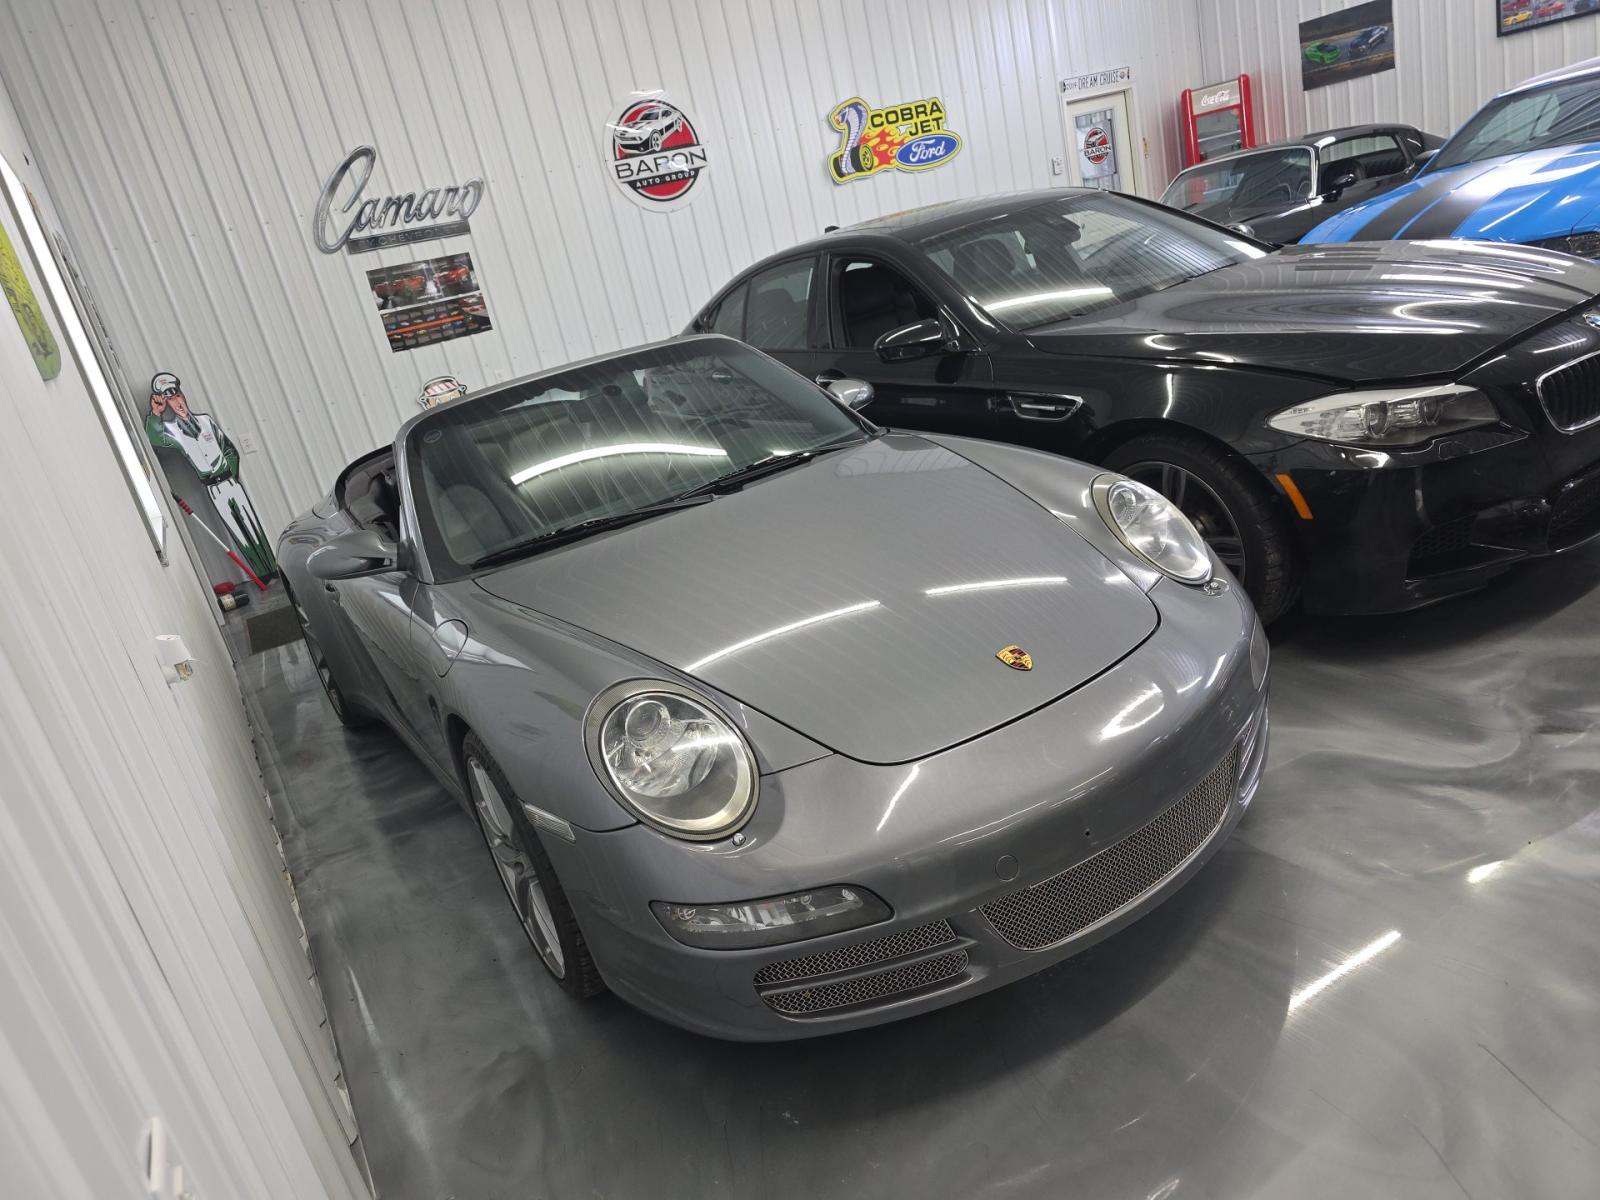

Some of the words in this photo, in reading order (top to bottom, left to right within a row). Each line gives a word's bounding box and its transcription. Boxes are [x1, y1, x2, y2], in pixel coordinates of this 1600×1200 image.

[1078, 74, 1098, 90] DREAM
[1100, 70, 1119, 86] CRUISE
[870, 101, 943, 128] COBRA
[909, 117, 943, 136] JET
[909, 139, 945, 162] Ford
[1084, 145, 1112, 157] BARON
[615, 148, 707, 179] BARON
[636, 177, 661, 188] AUTO
[665, 170, 695, 182] GROUP
[313, 144, 484, 255] Camaro
